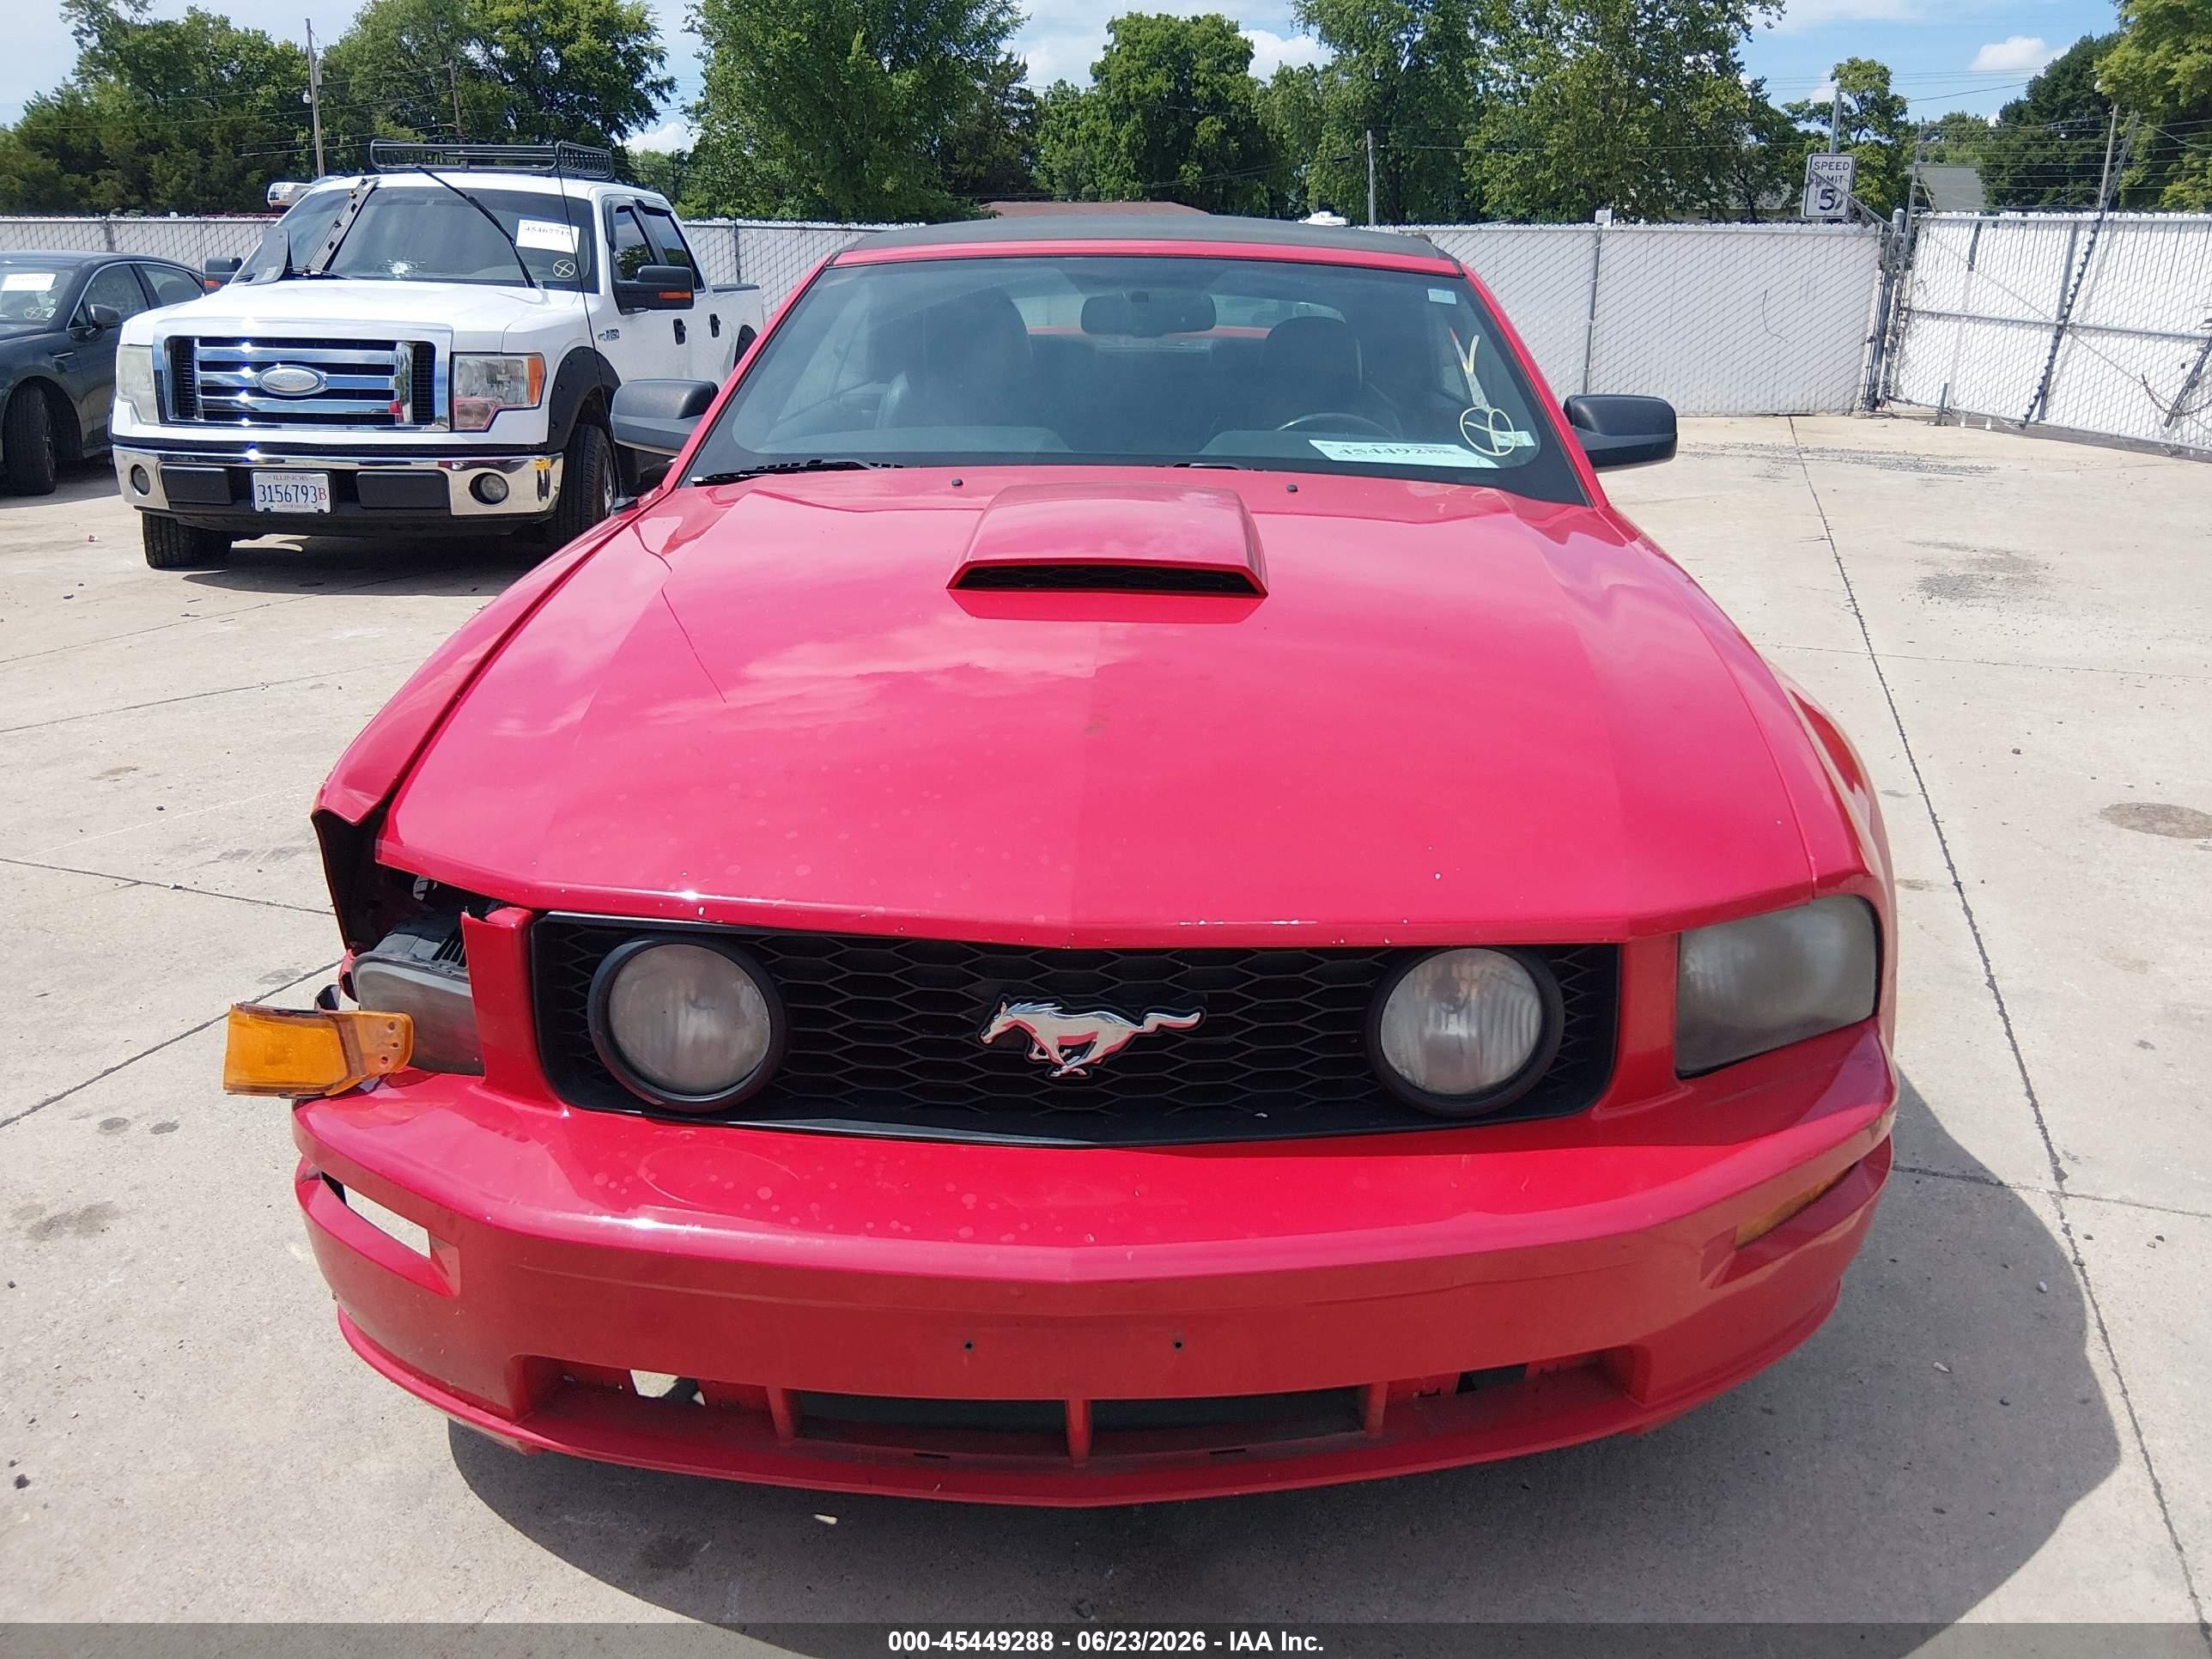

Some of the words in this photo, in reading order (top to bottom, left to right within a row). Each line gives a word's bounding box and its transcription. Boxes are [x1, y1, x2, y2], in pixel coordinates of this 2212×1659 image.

[1814, 161, 1850, 171] SPEED
[1819, 188, 1835, 211] 5
[258, 483, 318, 503] 3156793
[318, 487, 327, 501] B
